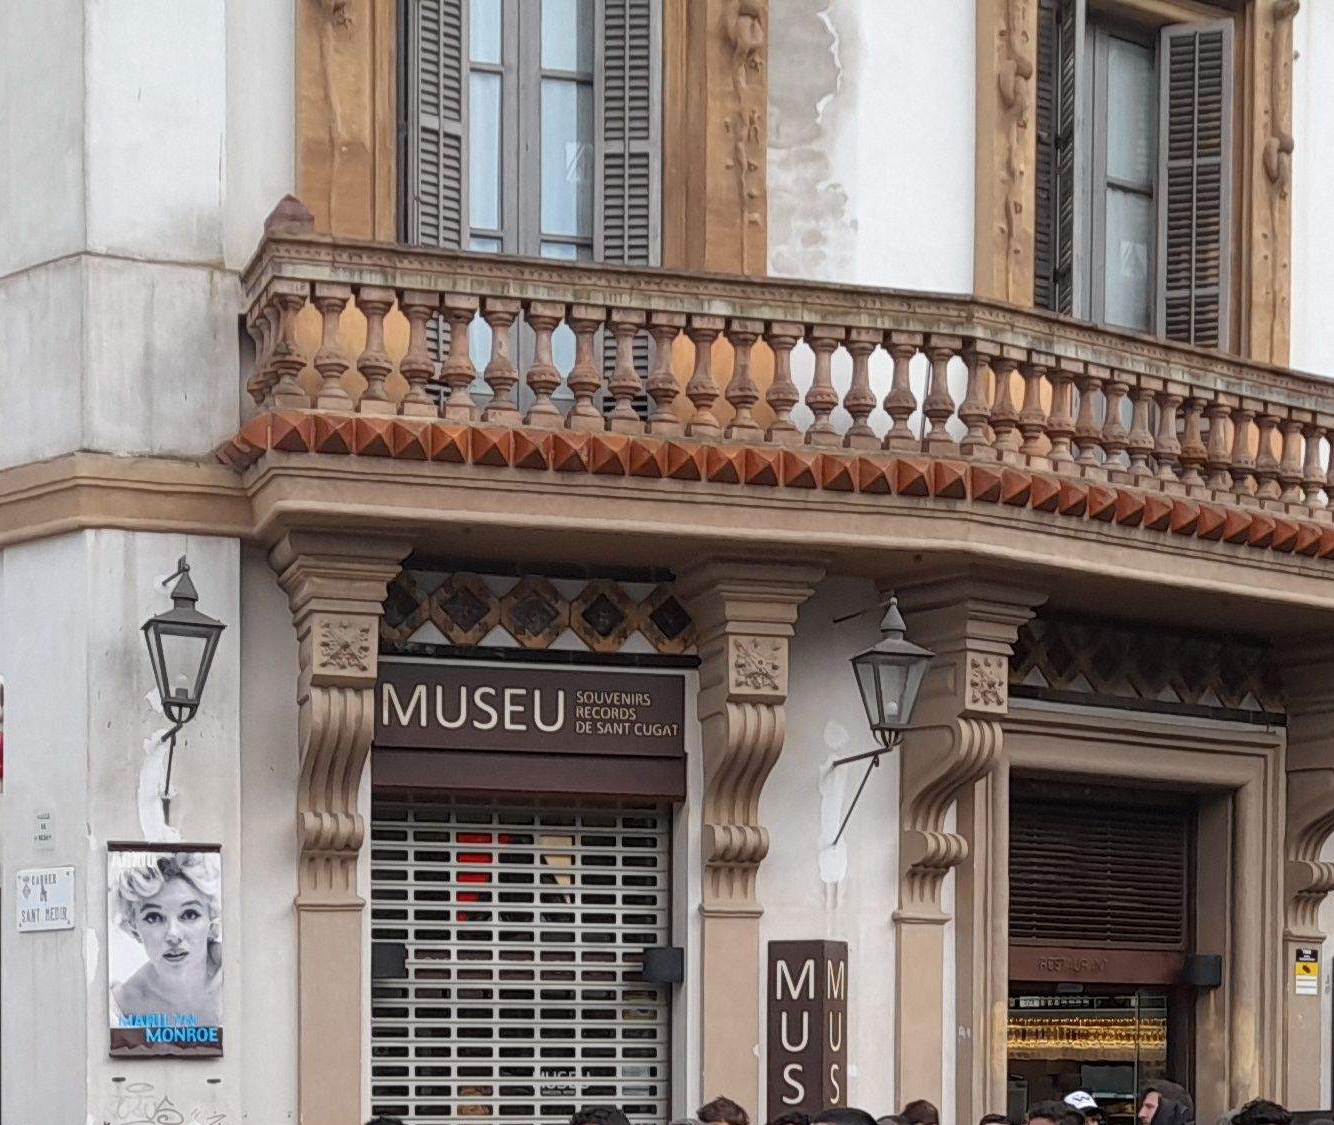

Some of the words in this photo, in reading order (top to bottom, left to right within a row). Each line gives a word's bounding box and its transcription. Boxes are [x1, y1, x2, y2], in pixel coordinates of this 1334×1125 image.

[576, 690, 651, 706] SOUVENIRS
[382, 683, 565, 732] MUSEU
[576, 706, 636, 721] RECORDS
[575, 721, 593, 735] DE
[596, 721, 631, 736] SANT
[634, 723, 679, 738] CUGAT
[32, 873, 57, 886] CARRER
[21, 908, 40, 922] SANT
[145, 1027, 219, 1043] MONROE
